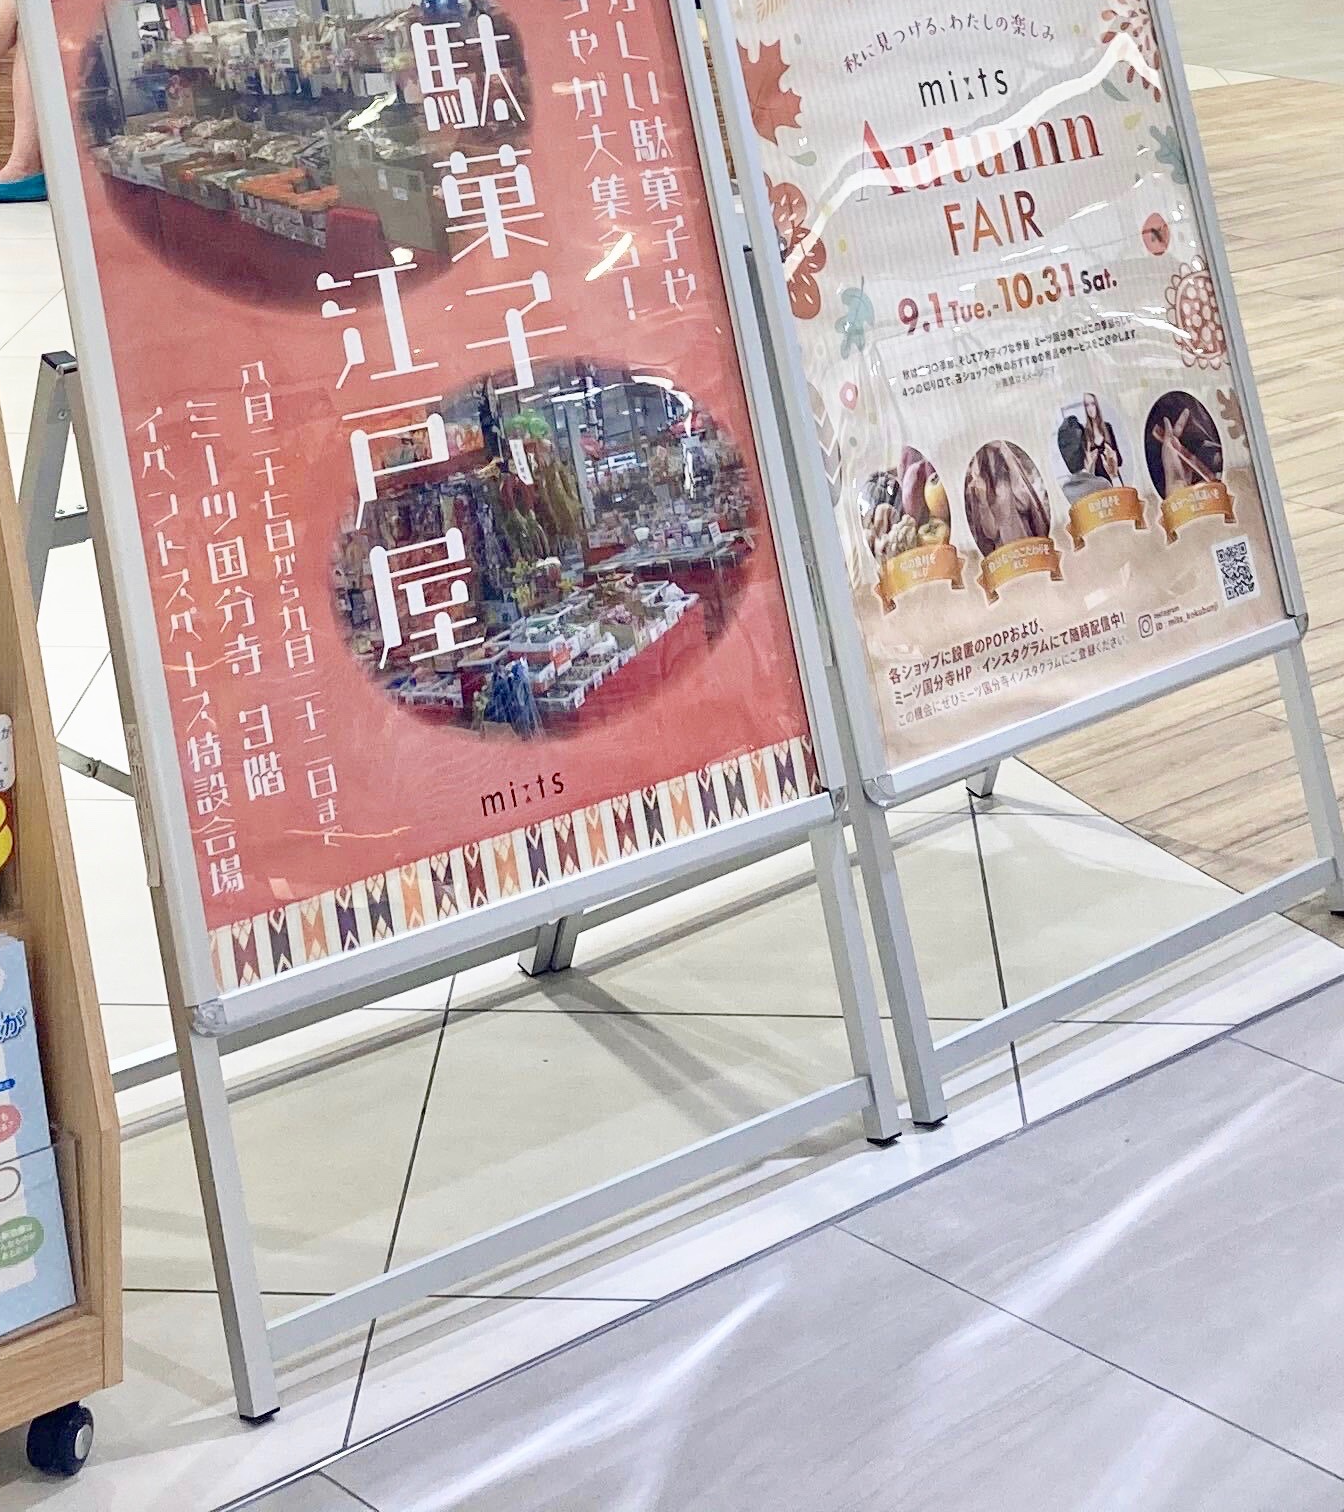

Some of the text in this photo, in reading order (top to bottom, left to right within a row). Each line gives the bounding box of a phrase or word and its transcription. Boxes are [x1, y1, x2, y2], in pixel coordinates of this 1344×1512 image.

[842, 13, 1056, 74] 秋に見つける、わたしの楽しみ
[855, 112, 1104, 203] Autumn
[943, 190, 1045, 257] FAIR
[135, 406, 246, 898] イベントスペース特設会場
[888, 617, 1045, 685] 各ショップに設置のPOPおよび、
